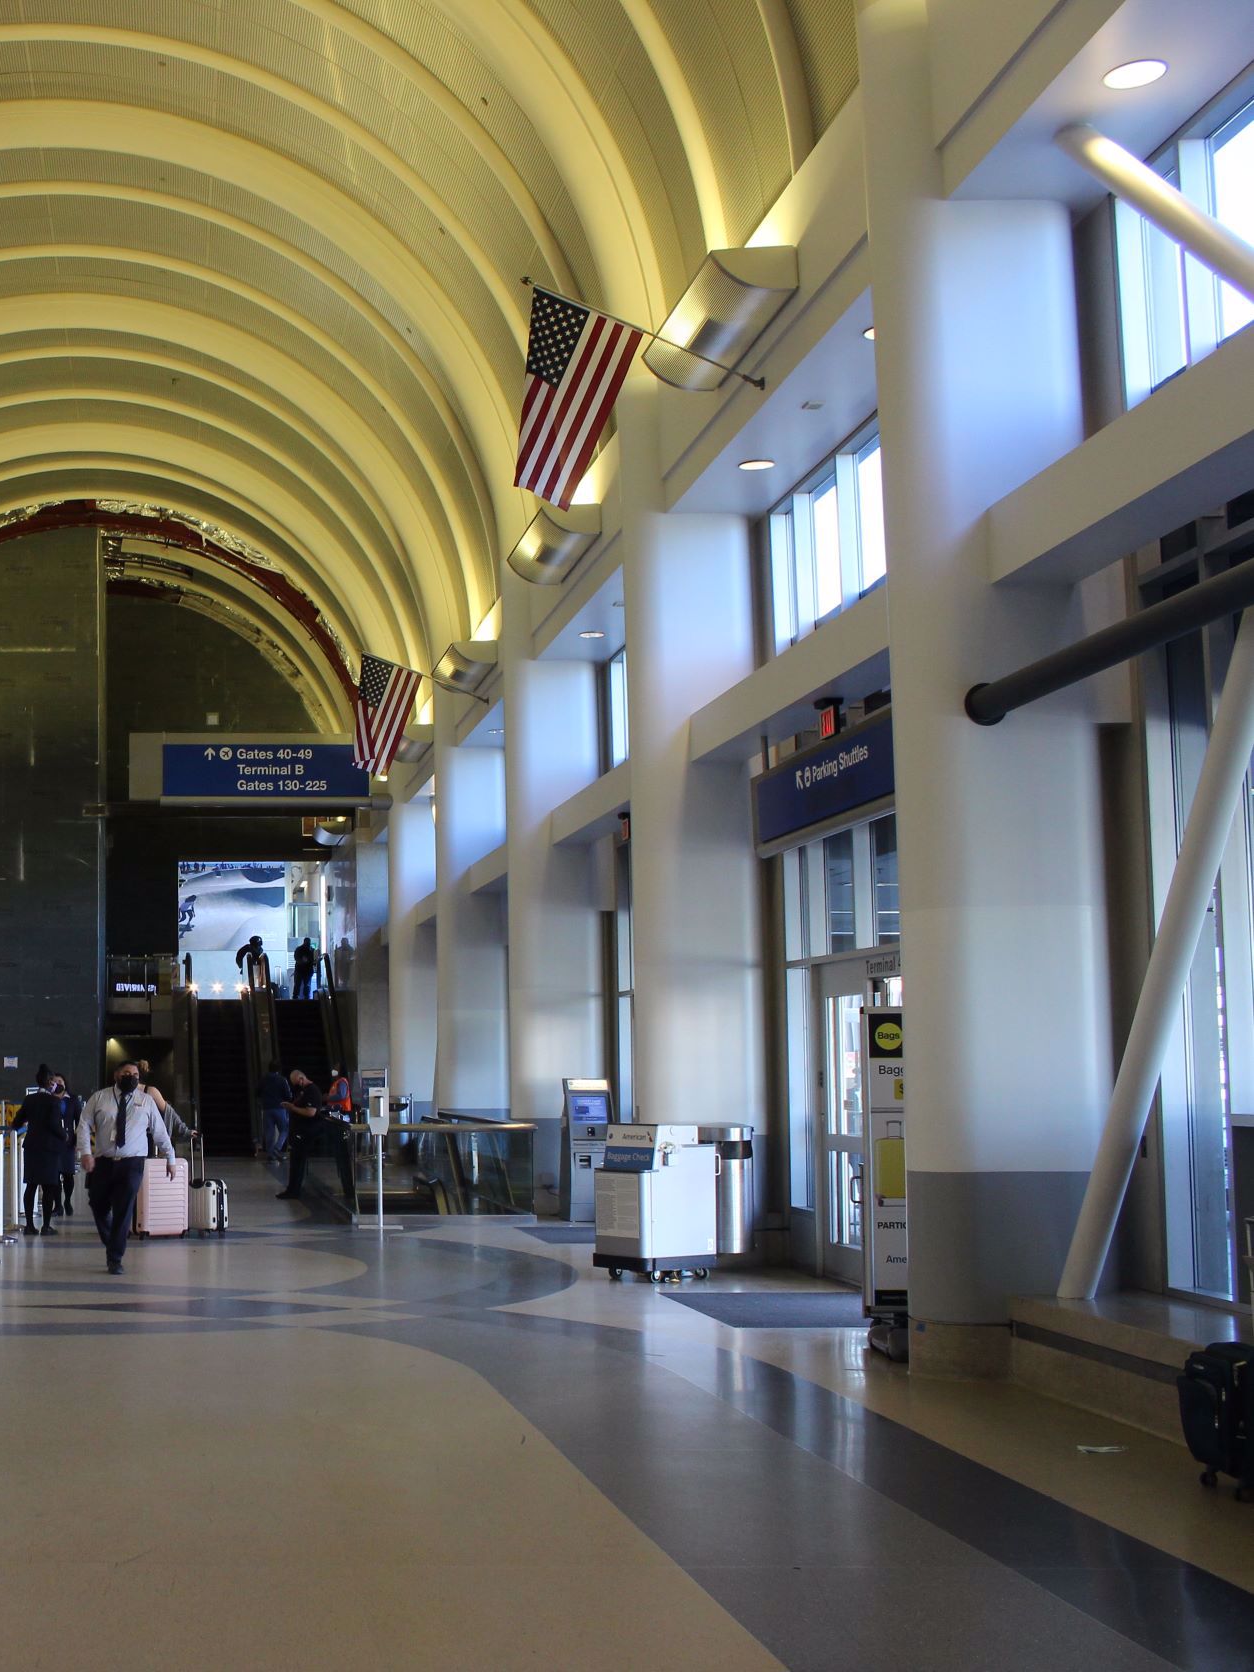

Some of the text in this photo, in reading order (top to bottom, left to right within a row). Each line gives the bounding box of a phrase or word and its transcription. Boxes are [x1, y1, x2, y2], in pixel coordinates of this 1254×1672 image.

[237, 749, 313, 760] Gates 40-49
[812, 745, 868, 782] Parking Shuttles
[237, 764, 304, 775] Terminal B
[237, 780, 327, 791] Gates 130-225
[866, 955, 896, 976] Terminal
[877, 1031, 900, 1042] Bags
[607, 1152, 650, 1162] Baggage Check
